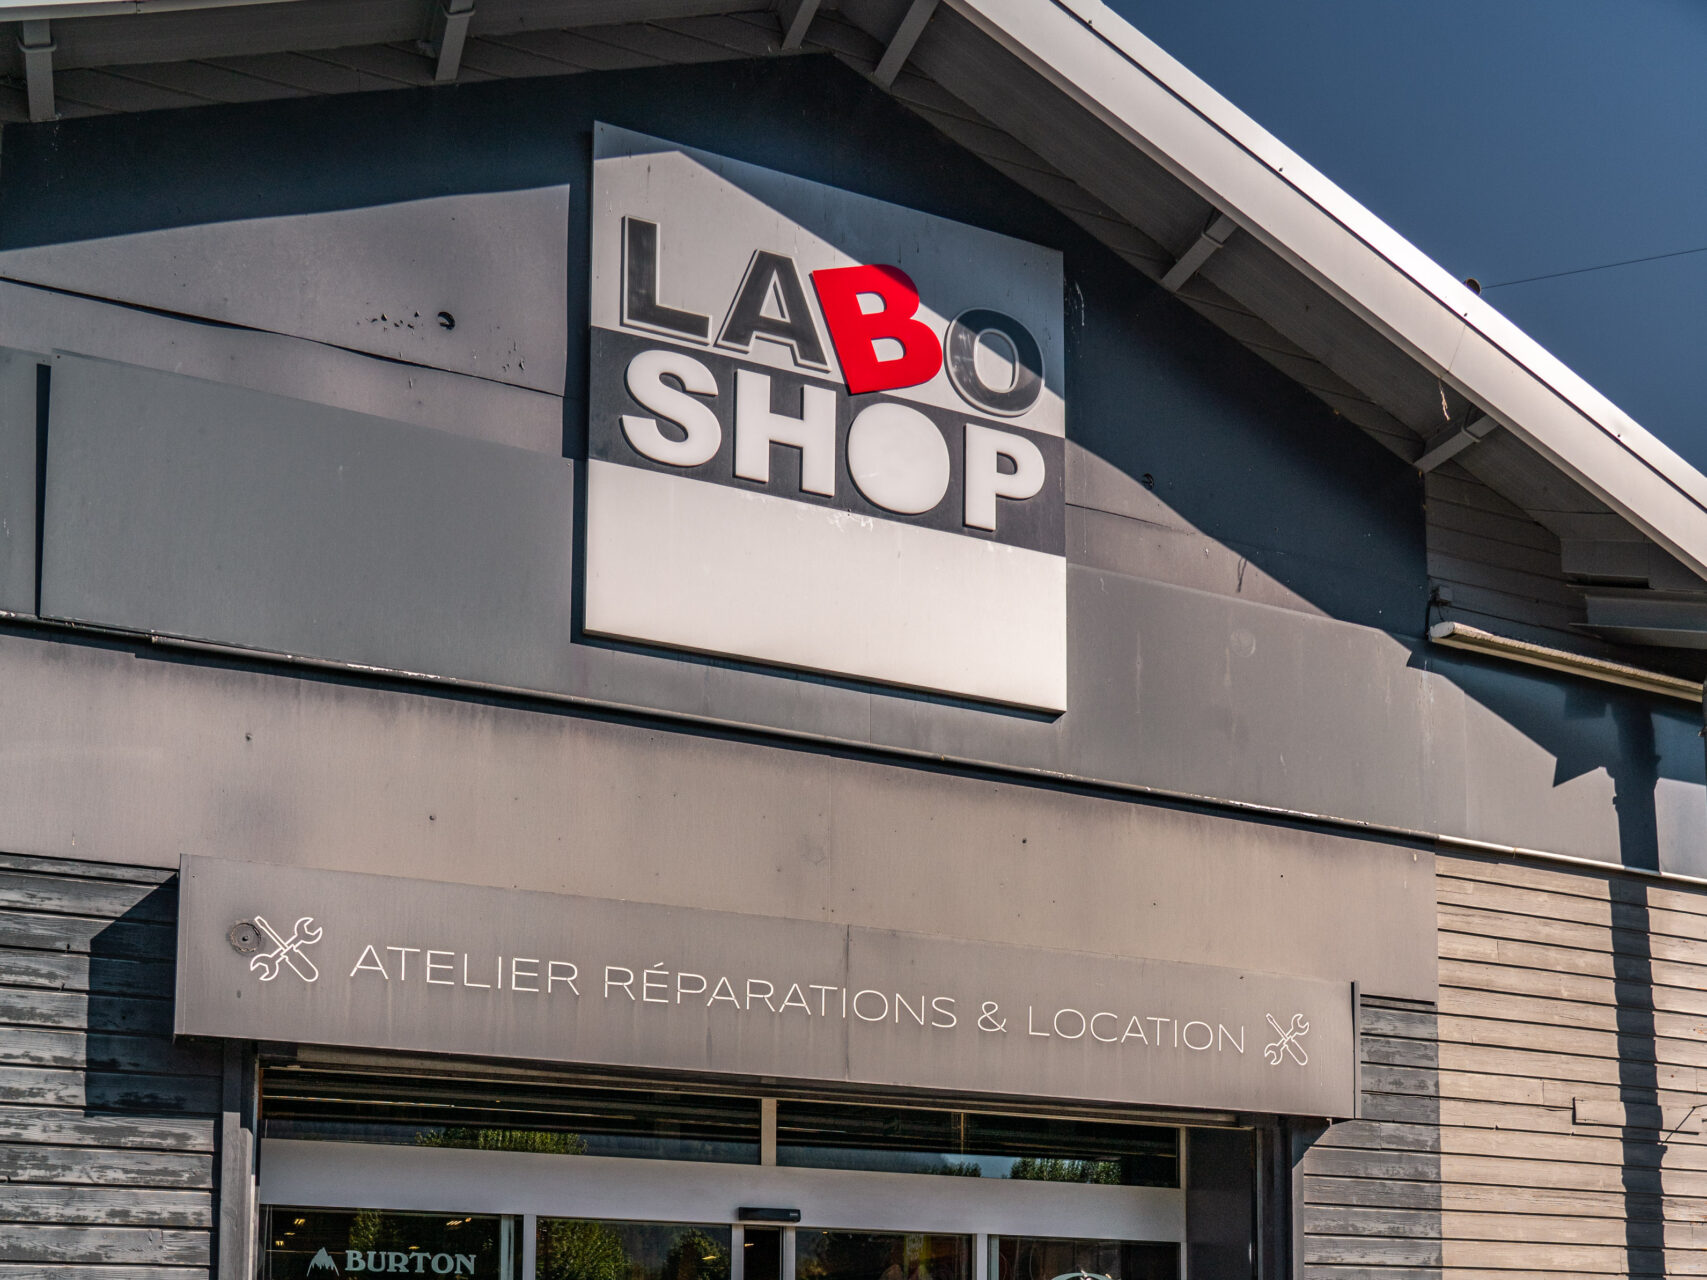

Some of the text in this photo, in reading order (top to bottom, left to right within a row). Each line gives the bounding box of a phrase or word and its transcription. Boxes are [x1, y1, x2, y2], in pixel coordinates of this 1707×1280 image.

[620, 214, 1045, 418] LABO
[620, 349, 1046, 532] SHOP
[350, 944, 1244, 1054] ATELIER RÉPARATIONS & LOCATION
[345, 1250, 476, 1274] BURTON
